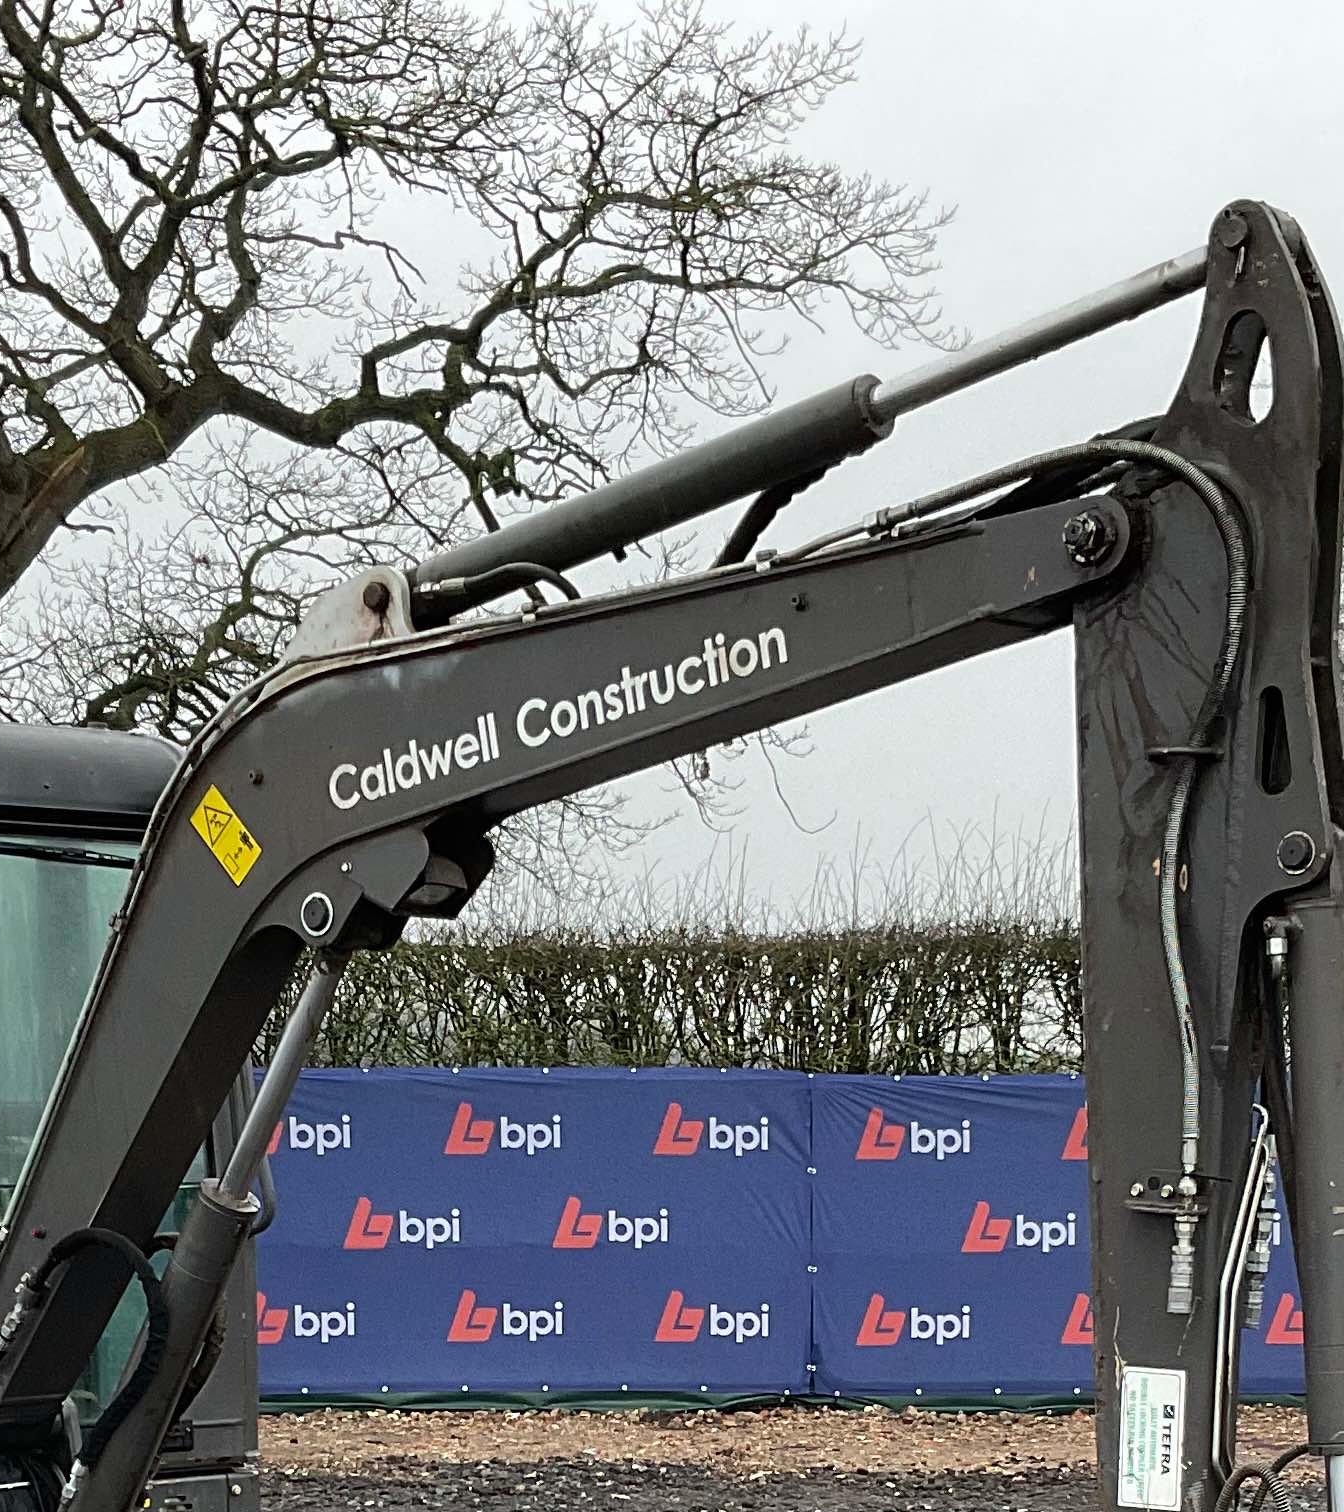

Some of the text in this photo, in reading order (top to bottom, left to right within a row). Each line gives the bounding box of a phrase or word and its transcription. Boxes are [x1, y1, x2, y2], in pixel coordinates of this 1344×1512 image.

[328, 626, 789, 809] Caldwell Construction
[289, 1114, 351, 1156] bpi
[500, 1114, 561, 1156] bpi
[709, 1116, 769, 1157] bpi
[910, 1119, 971, 1161] bpi
[399, 1208, 460, 1249] bpi
[608, 1208, 669, 1249] bpi
[1016, 1212, 1076, 1253] bpi
[294, 1302, 355, 1343] bpi
[502, 1301, 564, 1342] bpi
[710, 1303, 770, 1343] bpi
[910, 1305, 971, 1346] bpi
[1160, 1423, 1172, 1475] TEFRA
